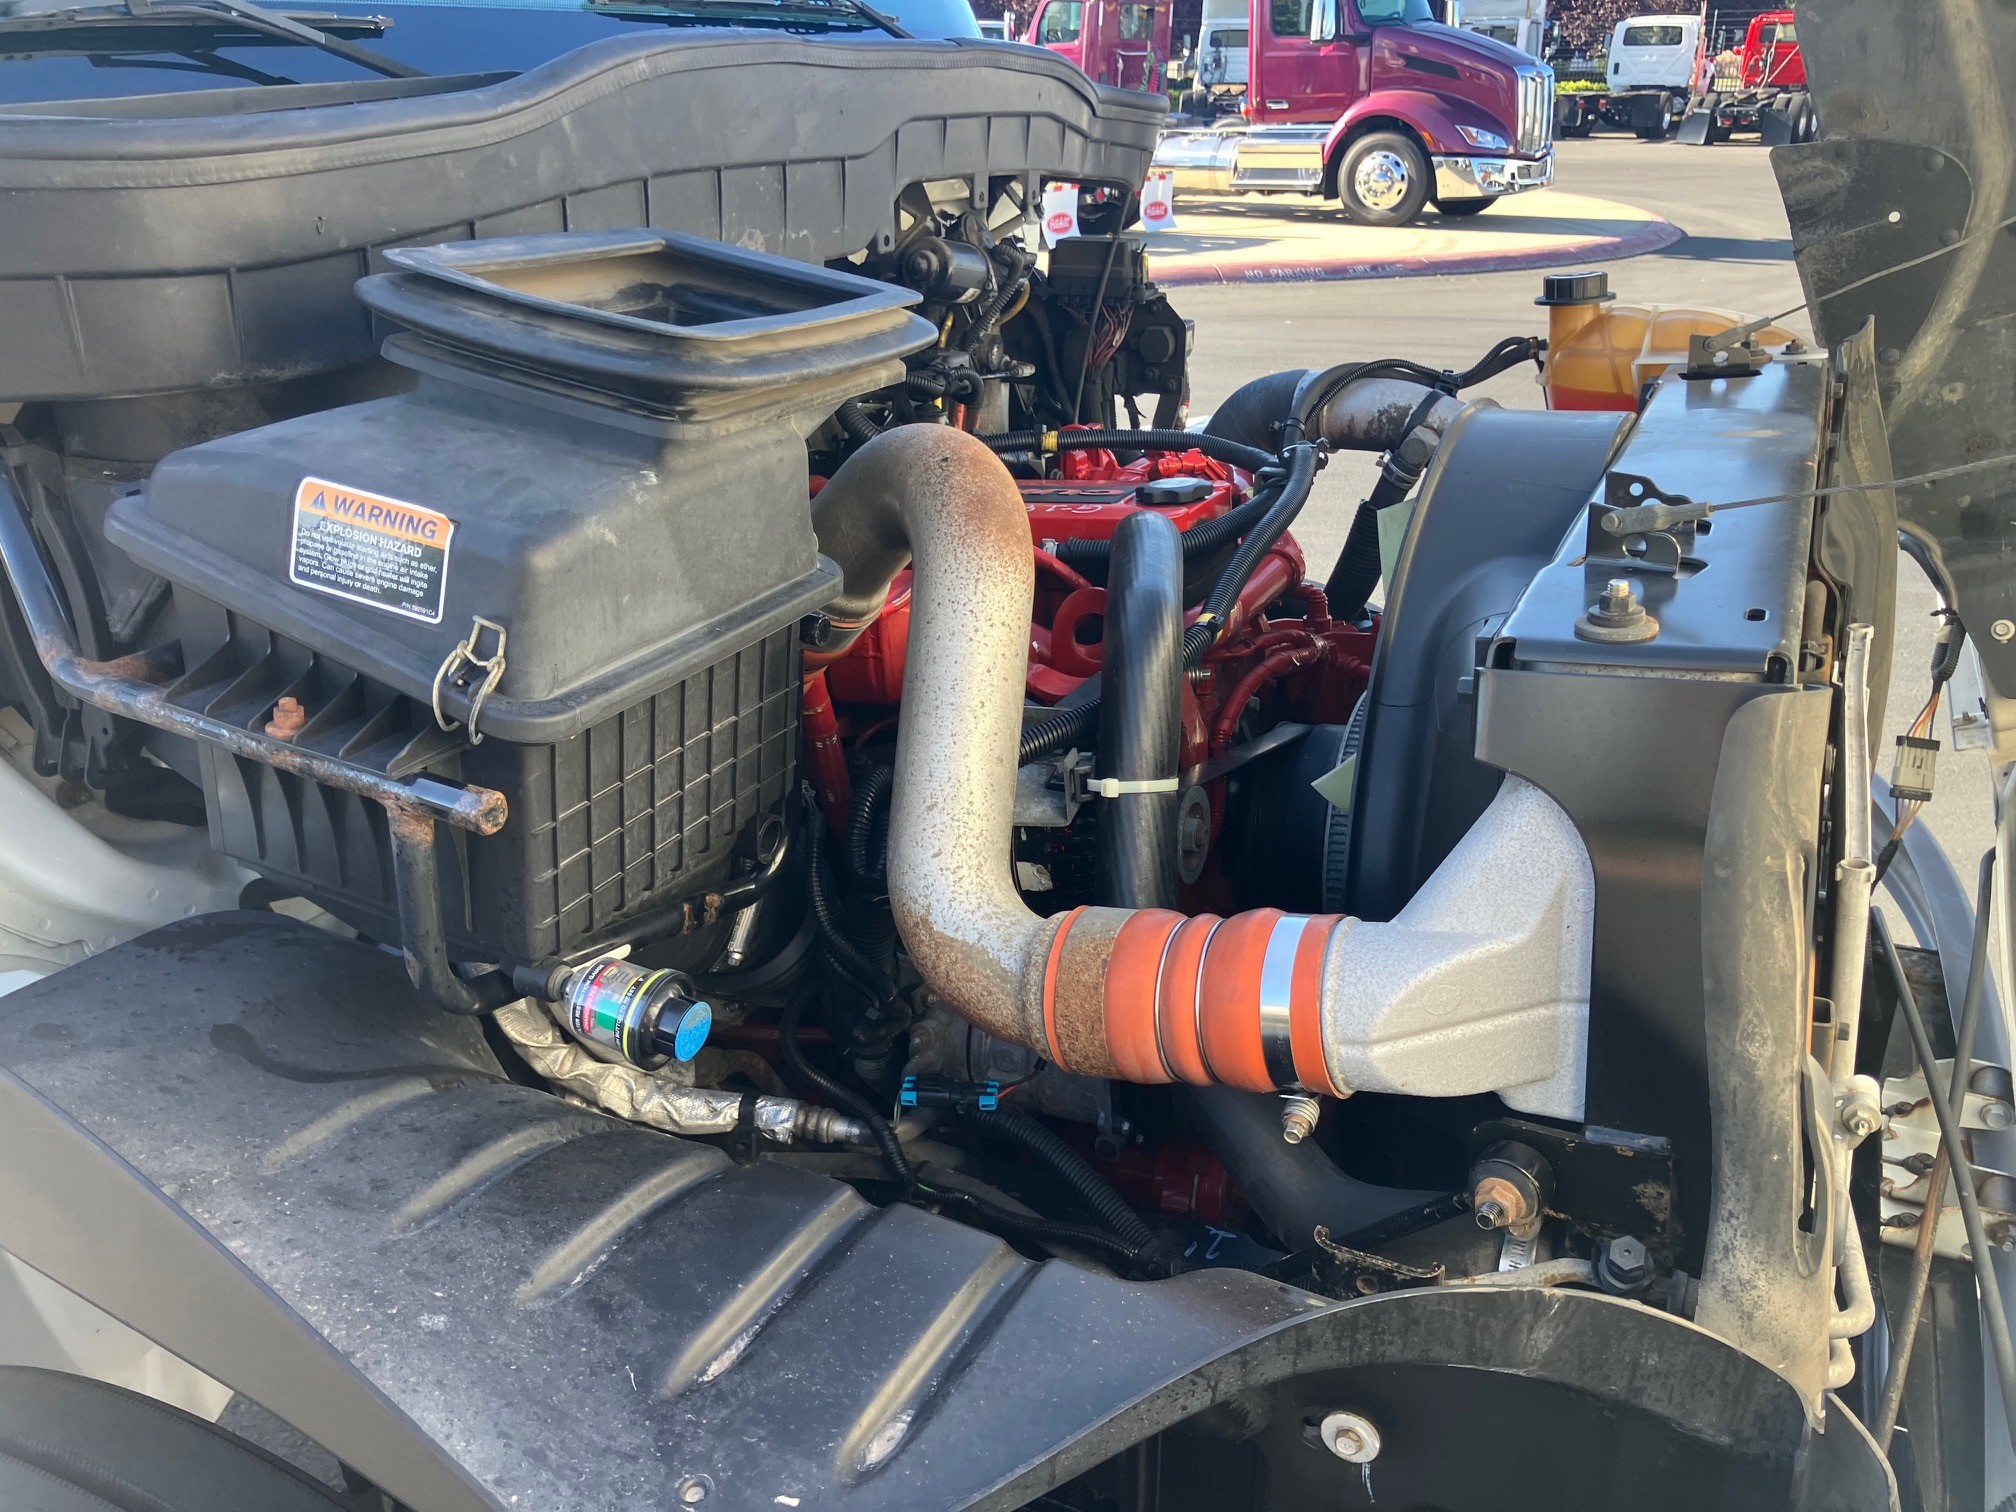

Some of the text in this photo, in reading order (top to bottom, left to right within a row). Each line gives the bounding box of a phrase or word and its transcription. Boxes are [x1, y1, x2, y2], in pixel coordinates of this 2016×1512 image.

[1244, 269, 1263, 280] NO
[1269, 268, 1324, 278] PARKING
[334, 494, 438, 541] WARNING
[300, 538, 324, 551] propane
[377, 559, 398, 572] engine
[409, 568, 428, 579] intake
[301, 528, 310, 536] Do
[394, 554, 409, 564] such
[419, 561, 437, 573] ether,
[320, 520, 422, 558] EXPLOSION HAZARD
[323, 552, 339, 563] Glow
[297, 563, 309, 573] and
[310, 566, 336, 582] personal
[337, 575, 353, 587] injury
[362, 582, 381, 594] death.
[298, 556, 423, 598] vapors. Can cause severe engine damage
[576, 980, 592, 1018] RESTRICTION
[588, 964, 606, 980] GAUGE
[614, 1014, 623, 1038] BUTTON
